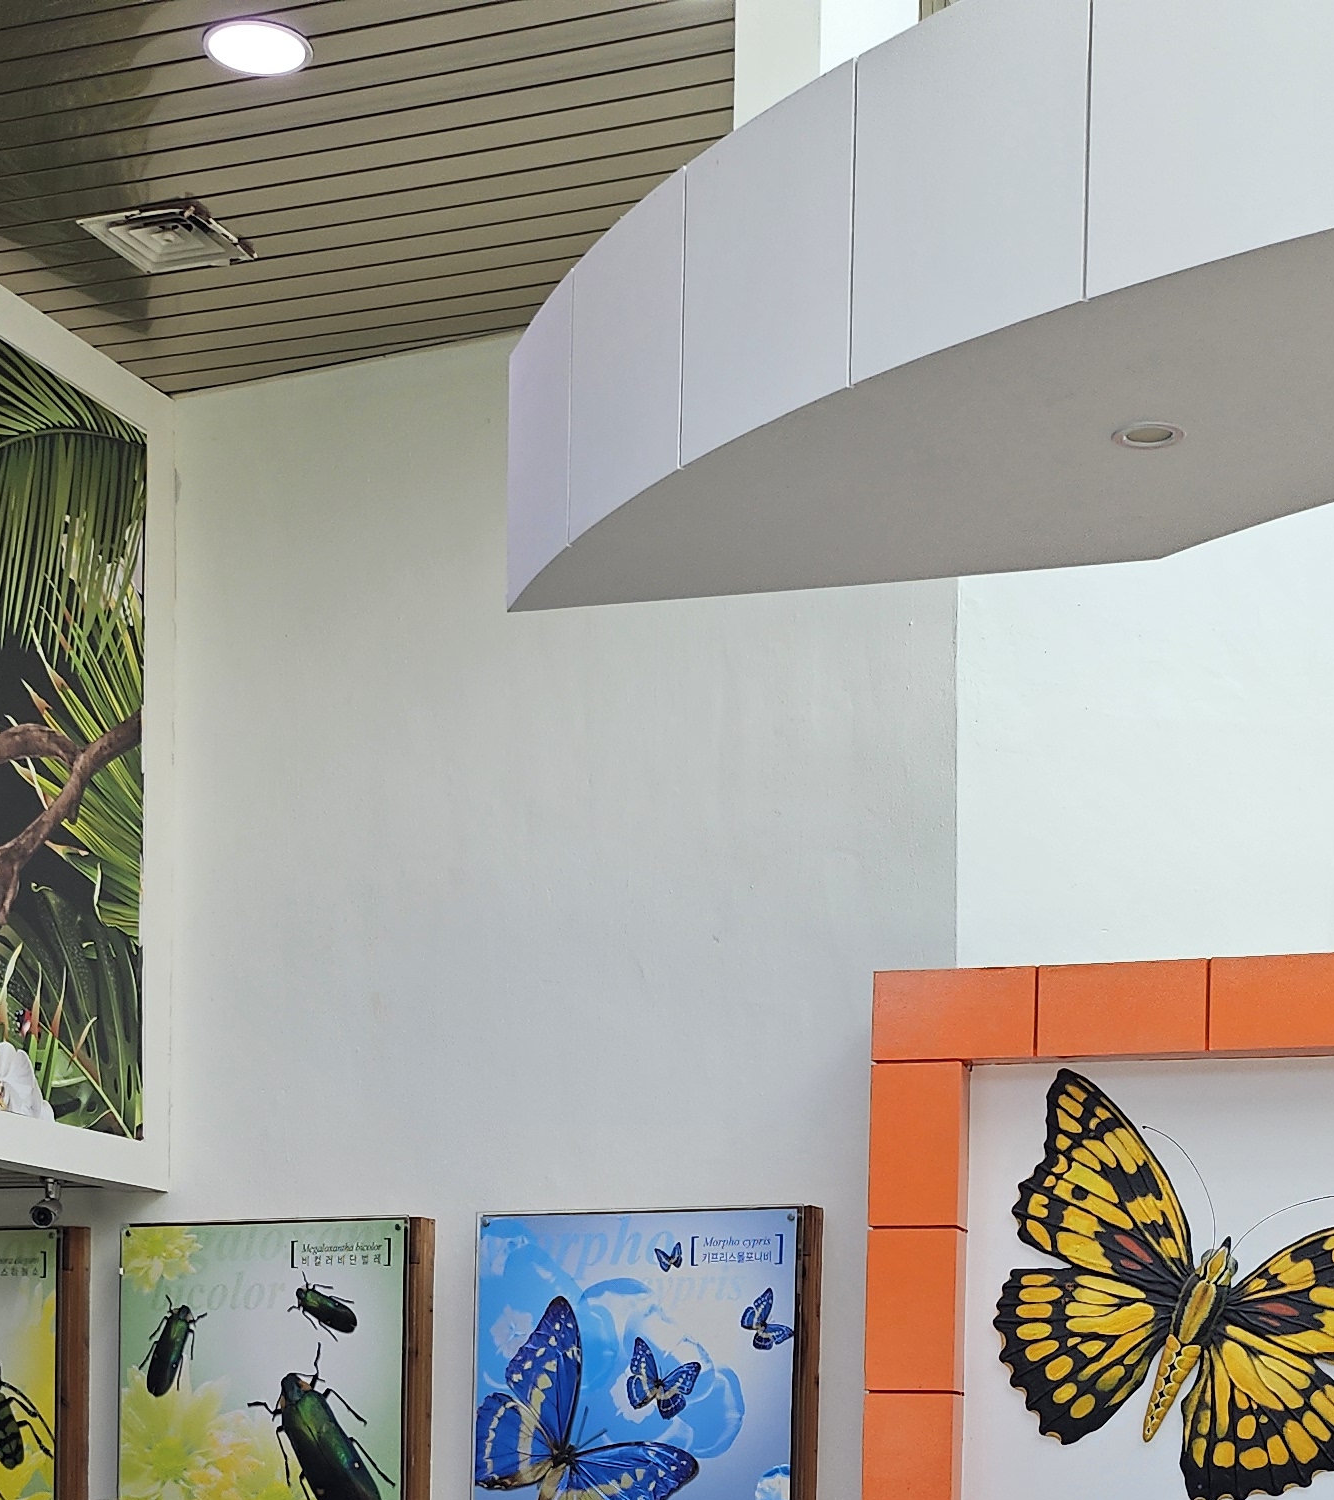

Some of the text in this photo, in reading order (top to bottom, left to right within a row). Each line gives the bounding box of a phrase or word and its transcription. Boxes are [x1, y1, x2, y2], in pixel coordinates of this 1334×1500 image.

[355, 1241, 383, 1252] bicolor
[703, 1236, 772, 1249] Morpho cypris
